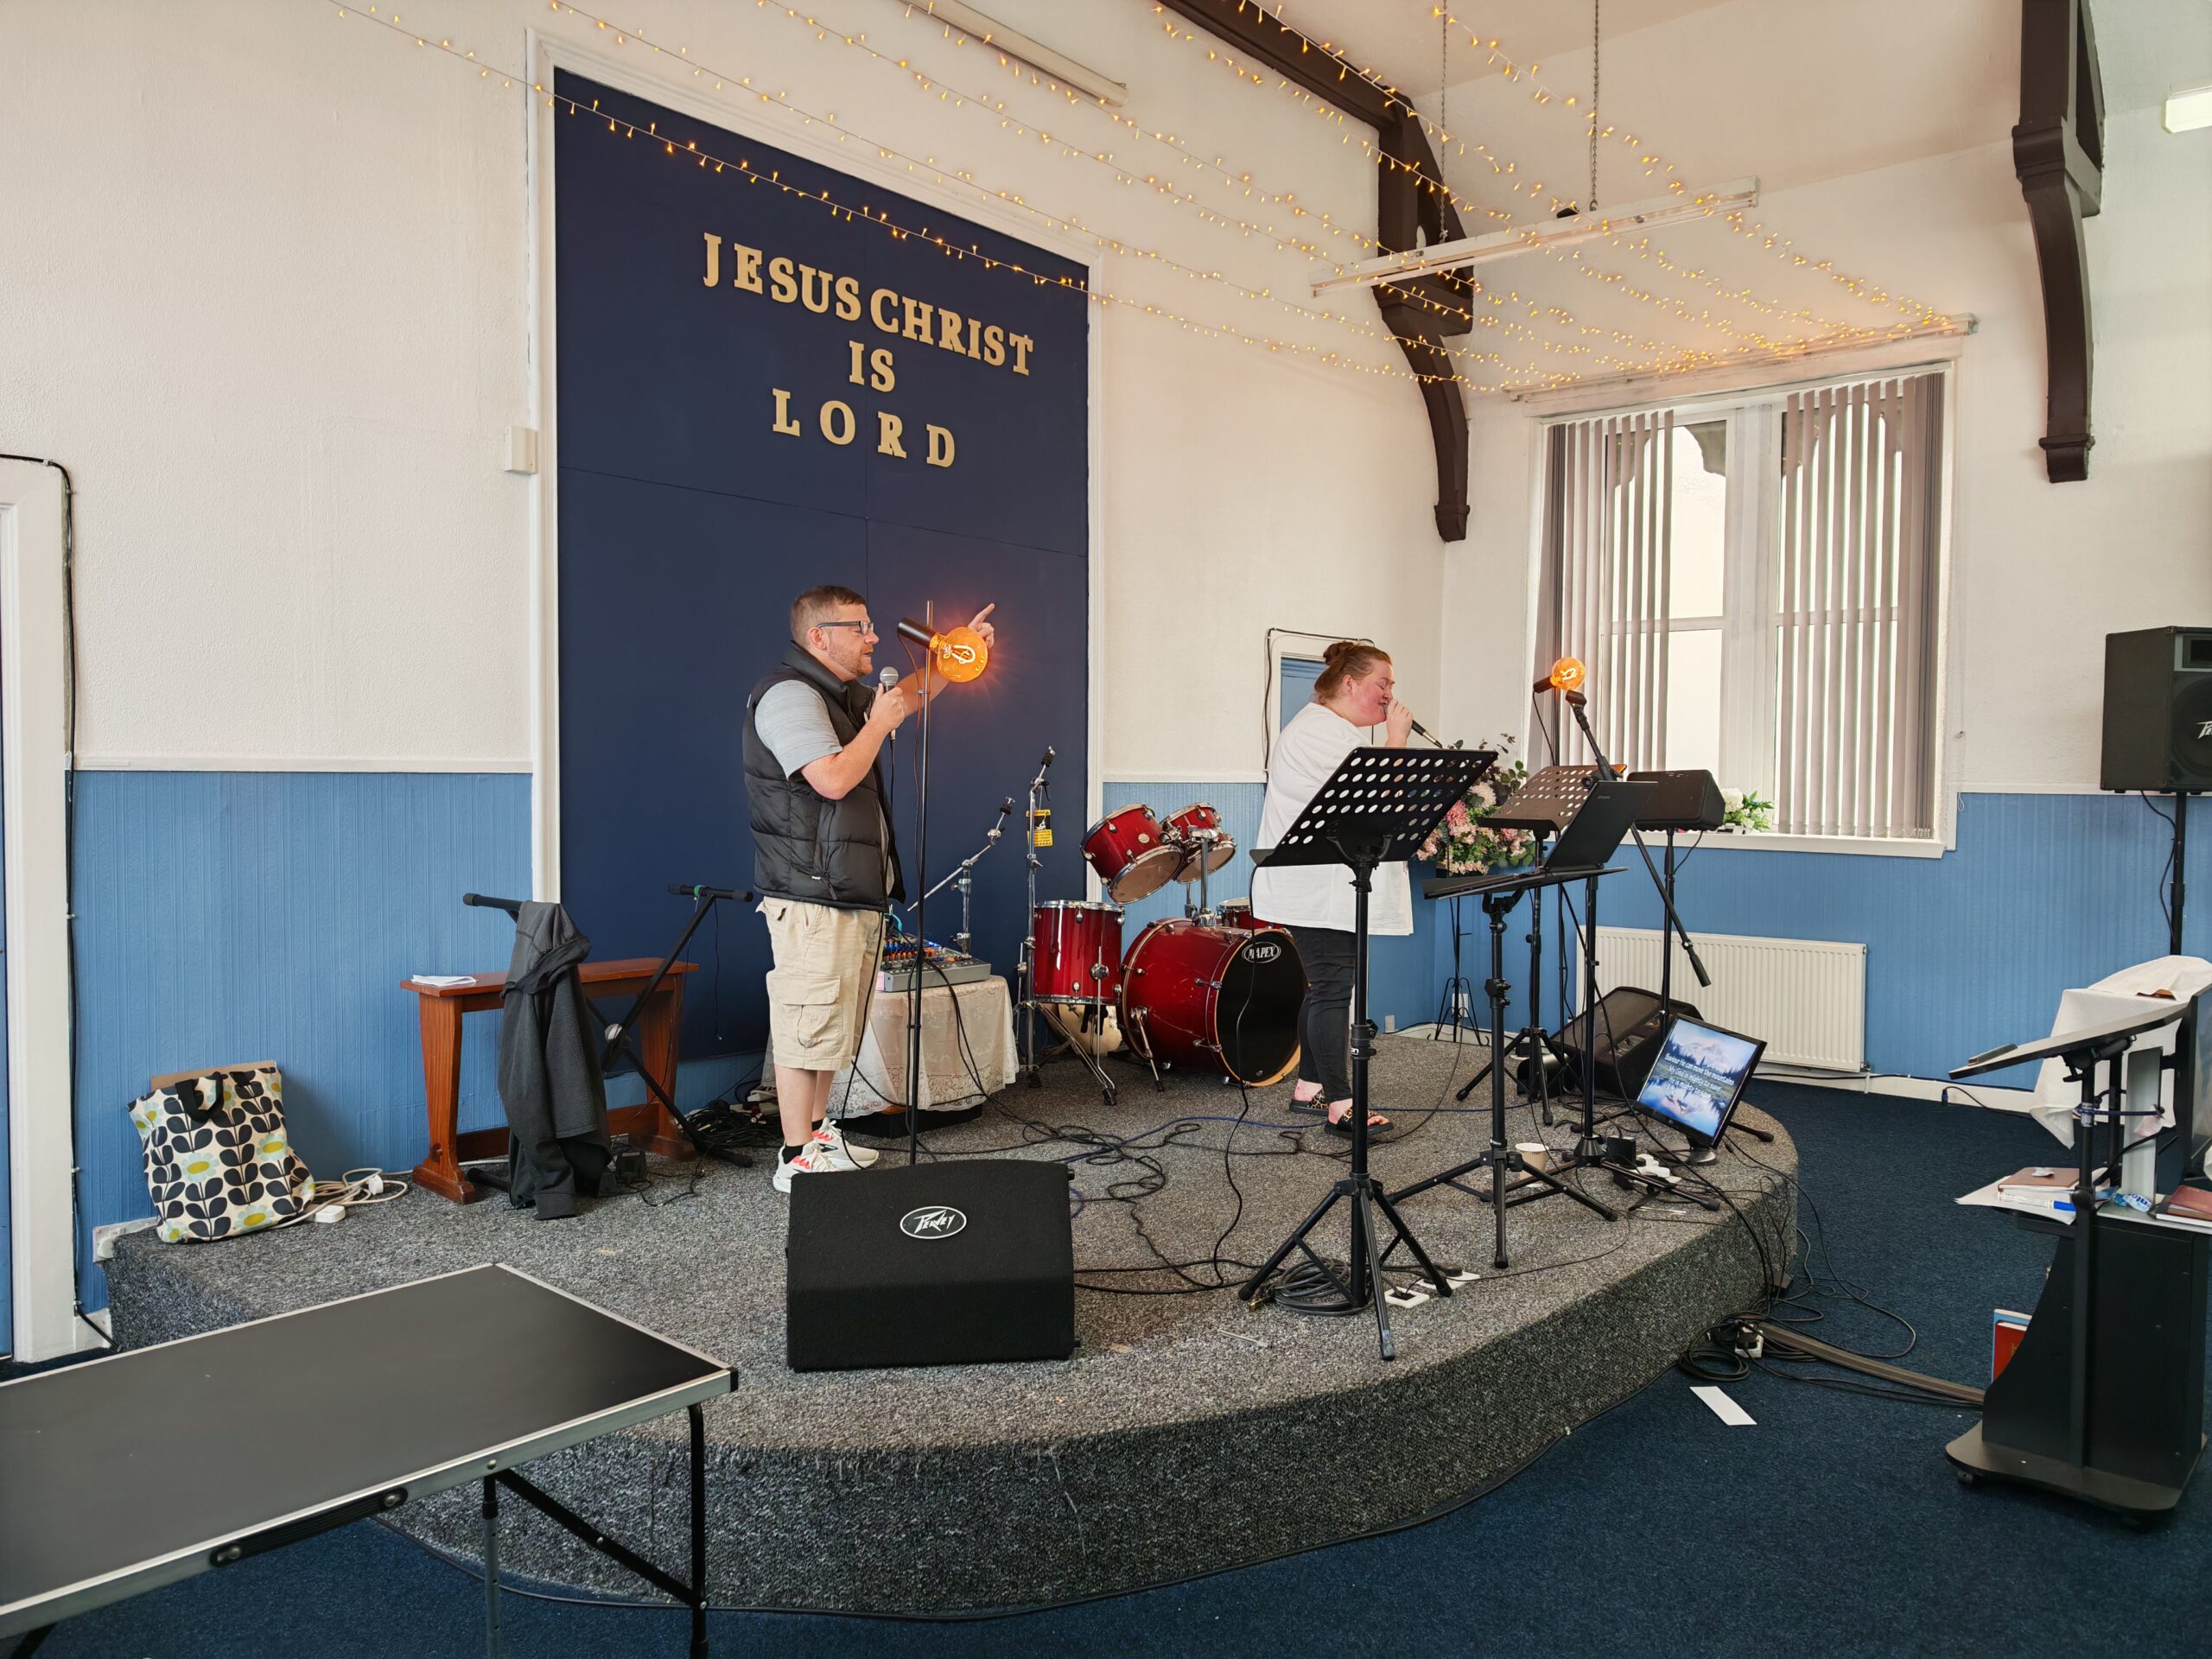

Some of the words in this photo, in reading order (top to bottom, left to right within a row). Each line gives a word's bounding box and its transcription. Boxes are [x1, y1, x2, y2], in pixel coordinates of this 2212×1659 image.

[702, 232, 862, 322] JESUS
[869, 288, 1034, 377] CHRIST
[849, 340, 896, 393] IS
[772, 387, 956, 468] LORD
[1248, 946, 1275, 960] MAPEX
